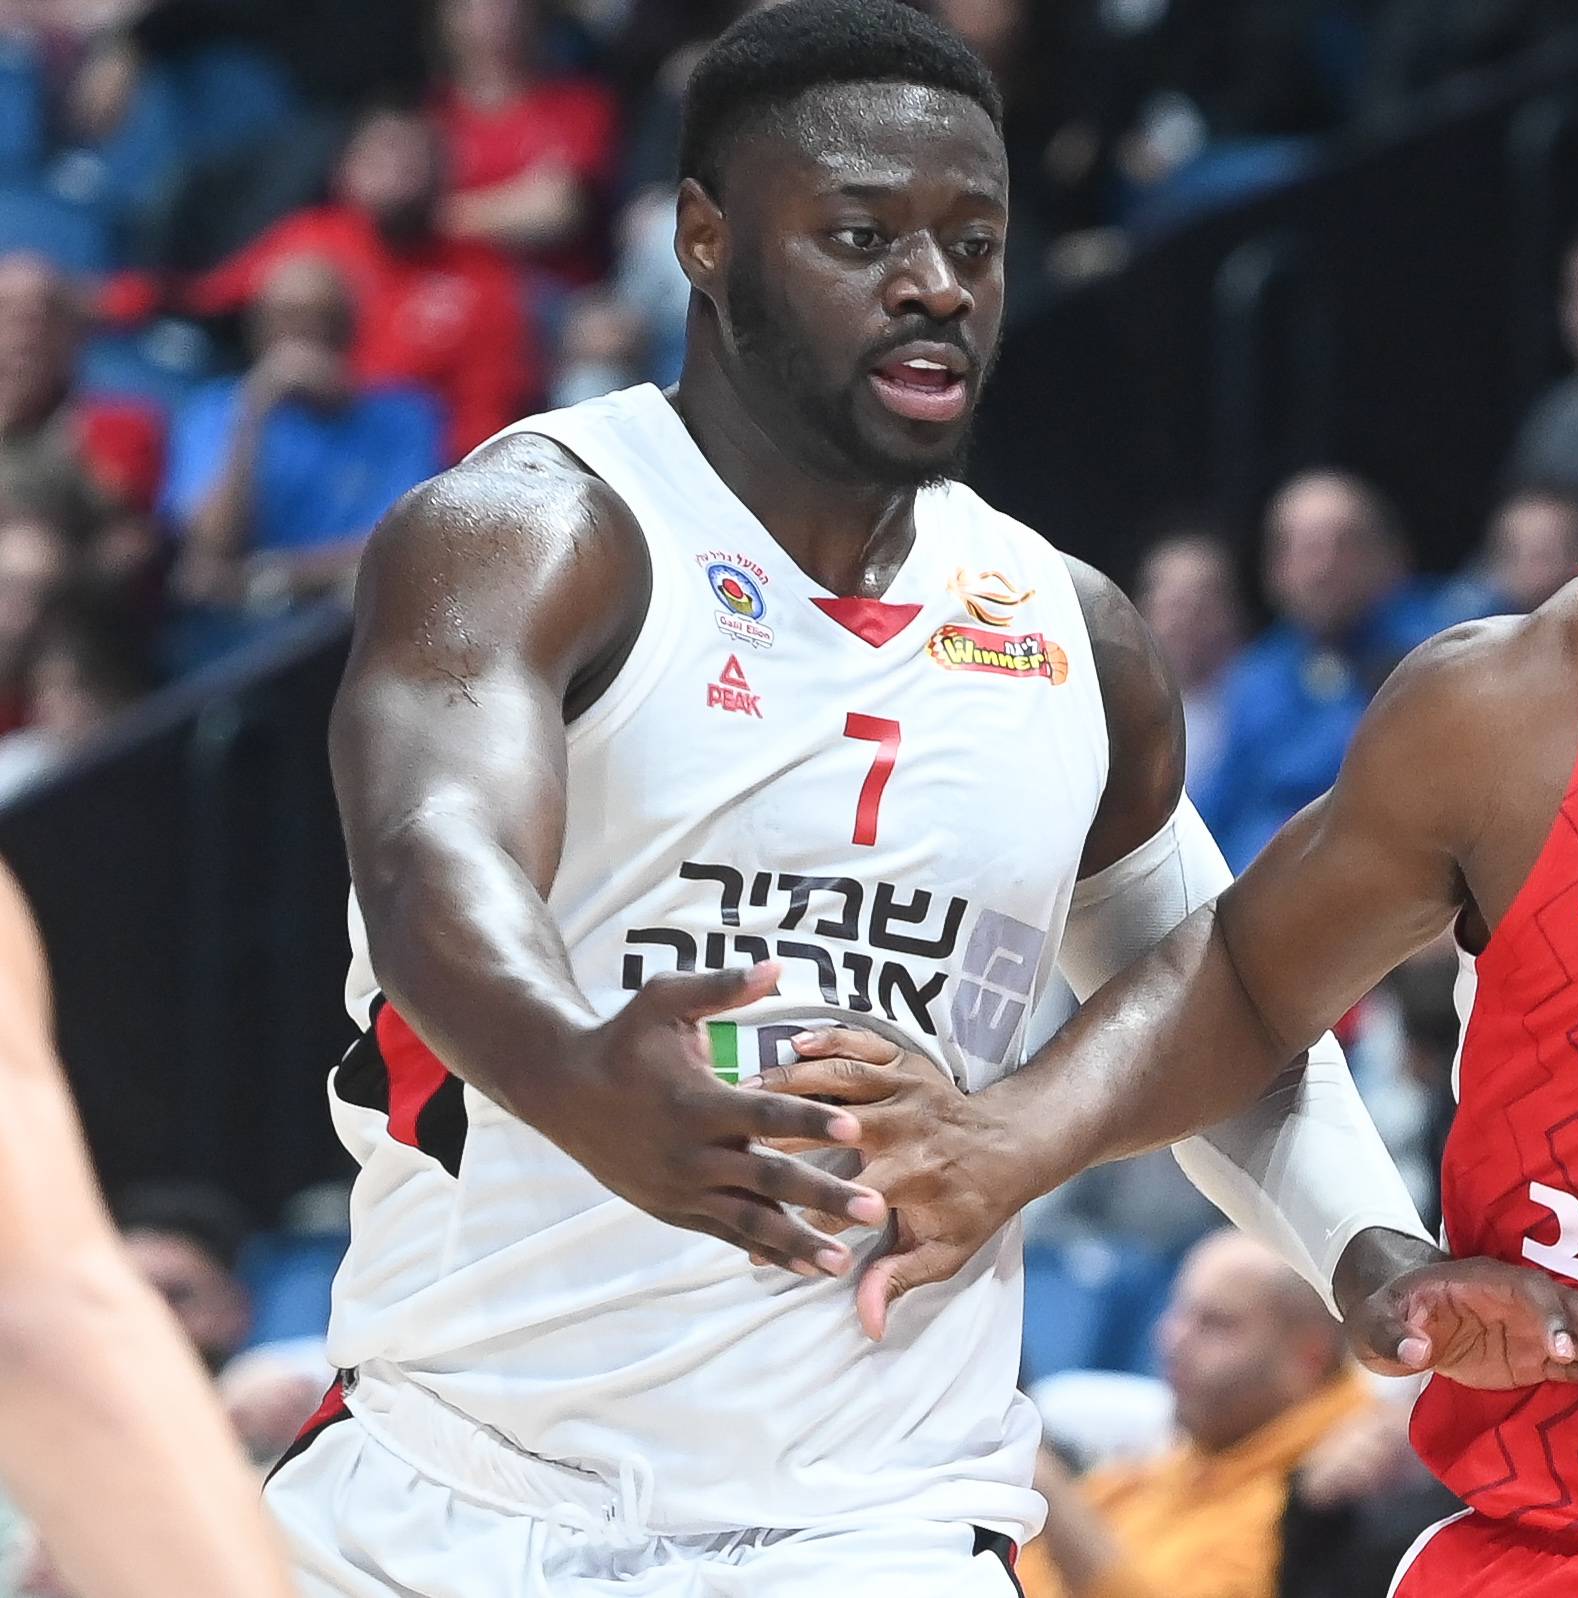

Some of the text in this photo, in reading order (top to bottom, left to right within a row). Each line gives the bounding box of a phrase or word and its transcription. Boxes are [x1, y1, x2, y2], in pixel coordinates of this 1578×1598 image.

[736, 553, 769, 585] הפועל
[706, 682, 763, 719] PEAK
[843, 712, 901, 847] 7
[679, 861, 969, 959] שמיר
